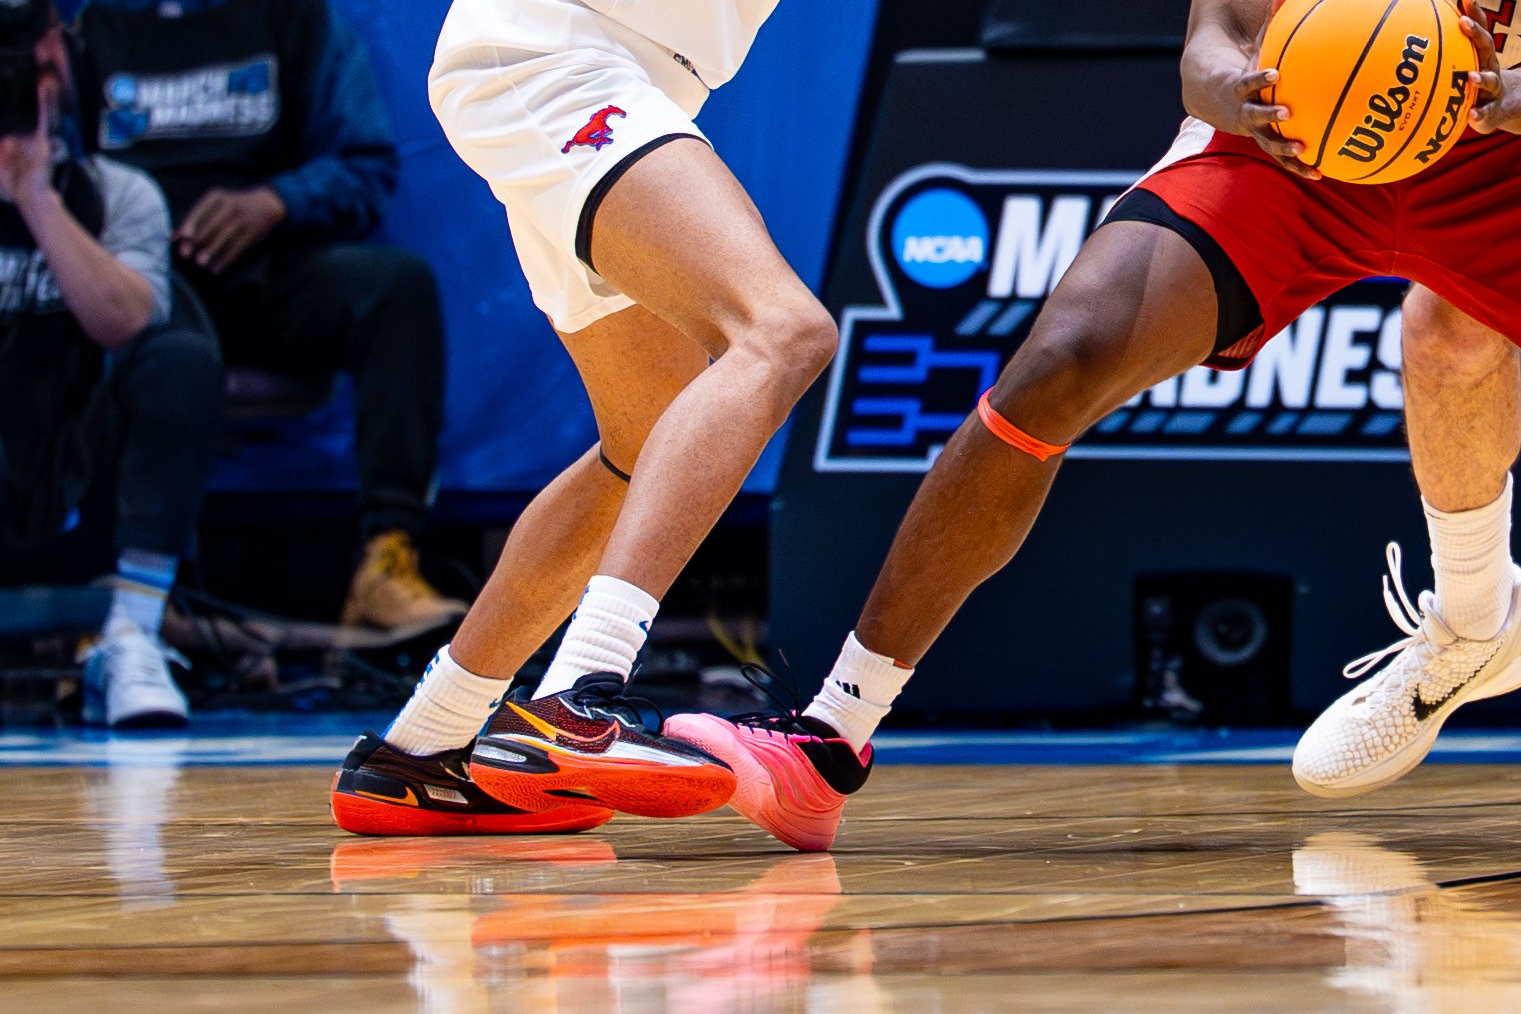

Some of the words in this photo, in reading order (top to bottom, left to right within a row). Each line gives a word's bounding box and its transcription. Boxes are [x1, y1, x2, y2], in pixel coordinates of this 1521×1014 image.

[1336, 34, 1430, 164] Wilson
[1413, 70, 1468, 164] NCAA
[902, 235, 984, 264] NCAA
